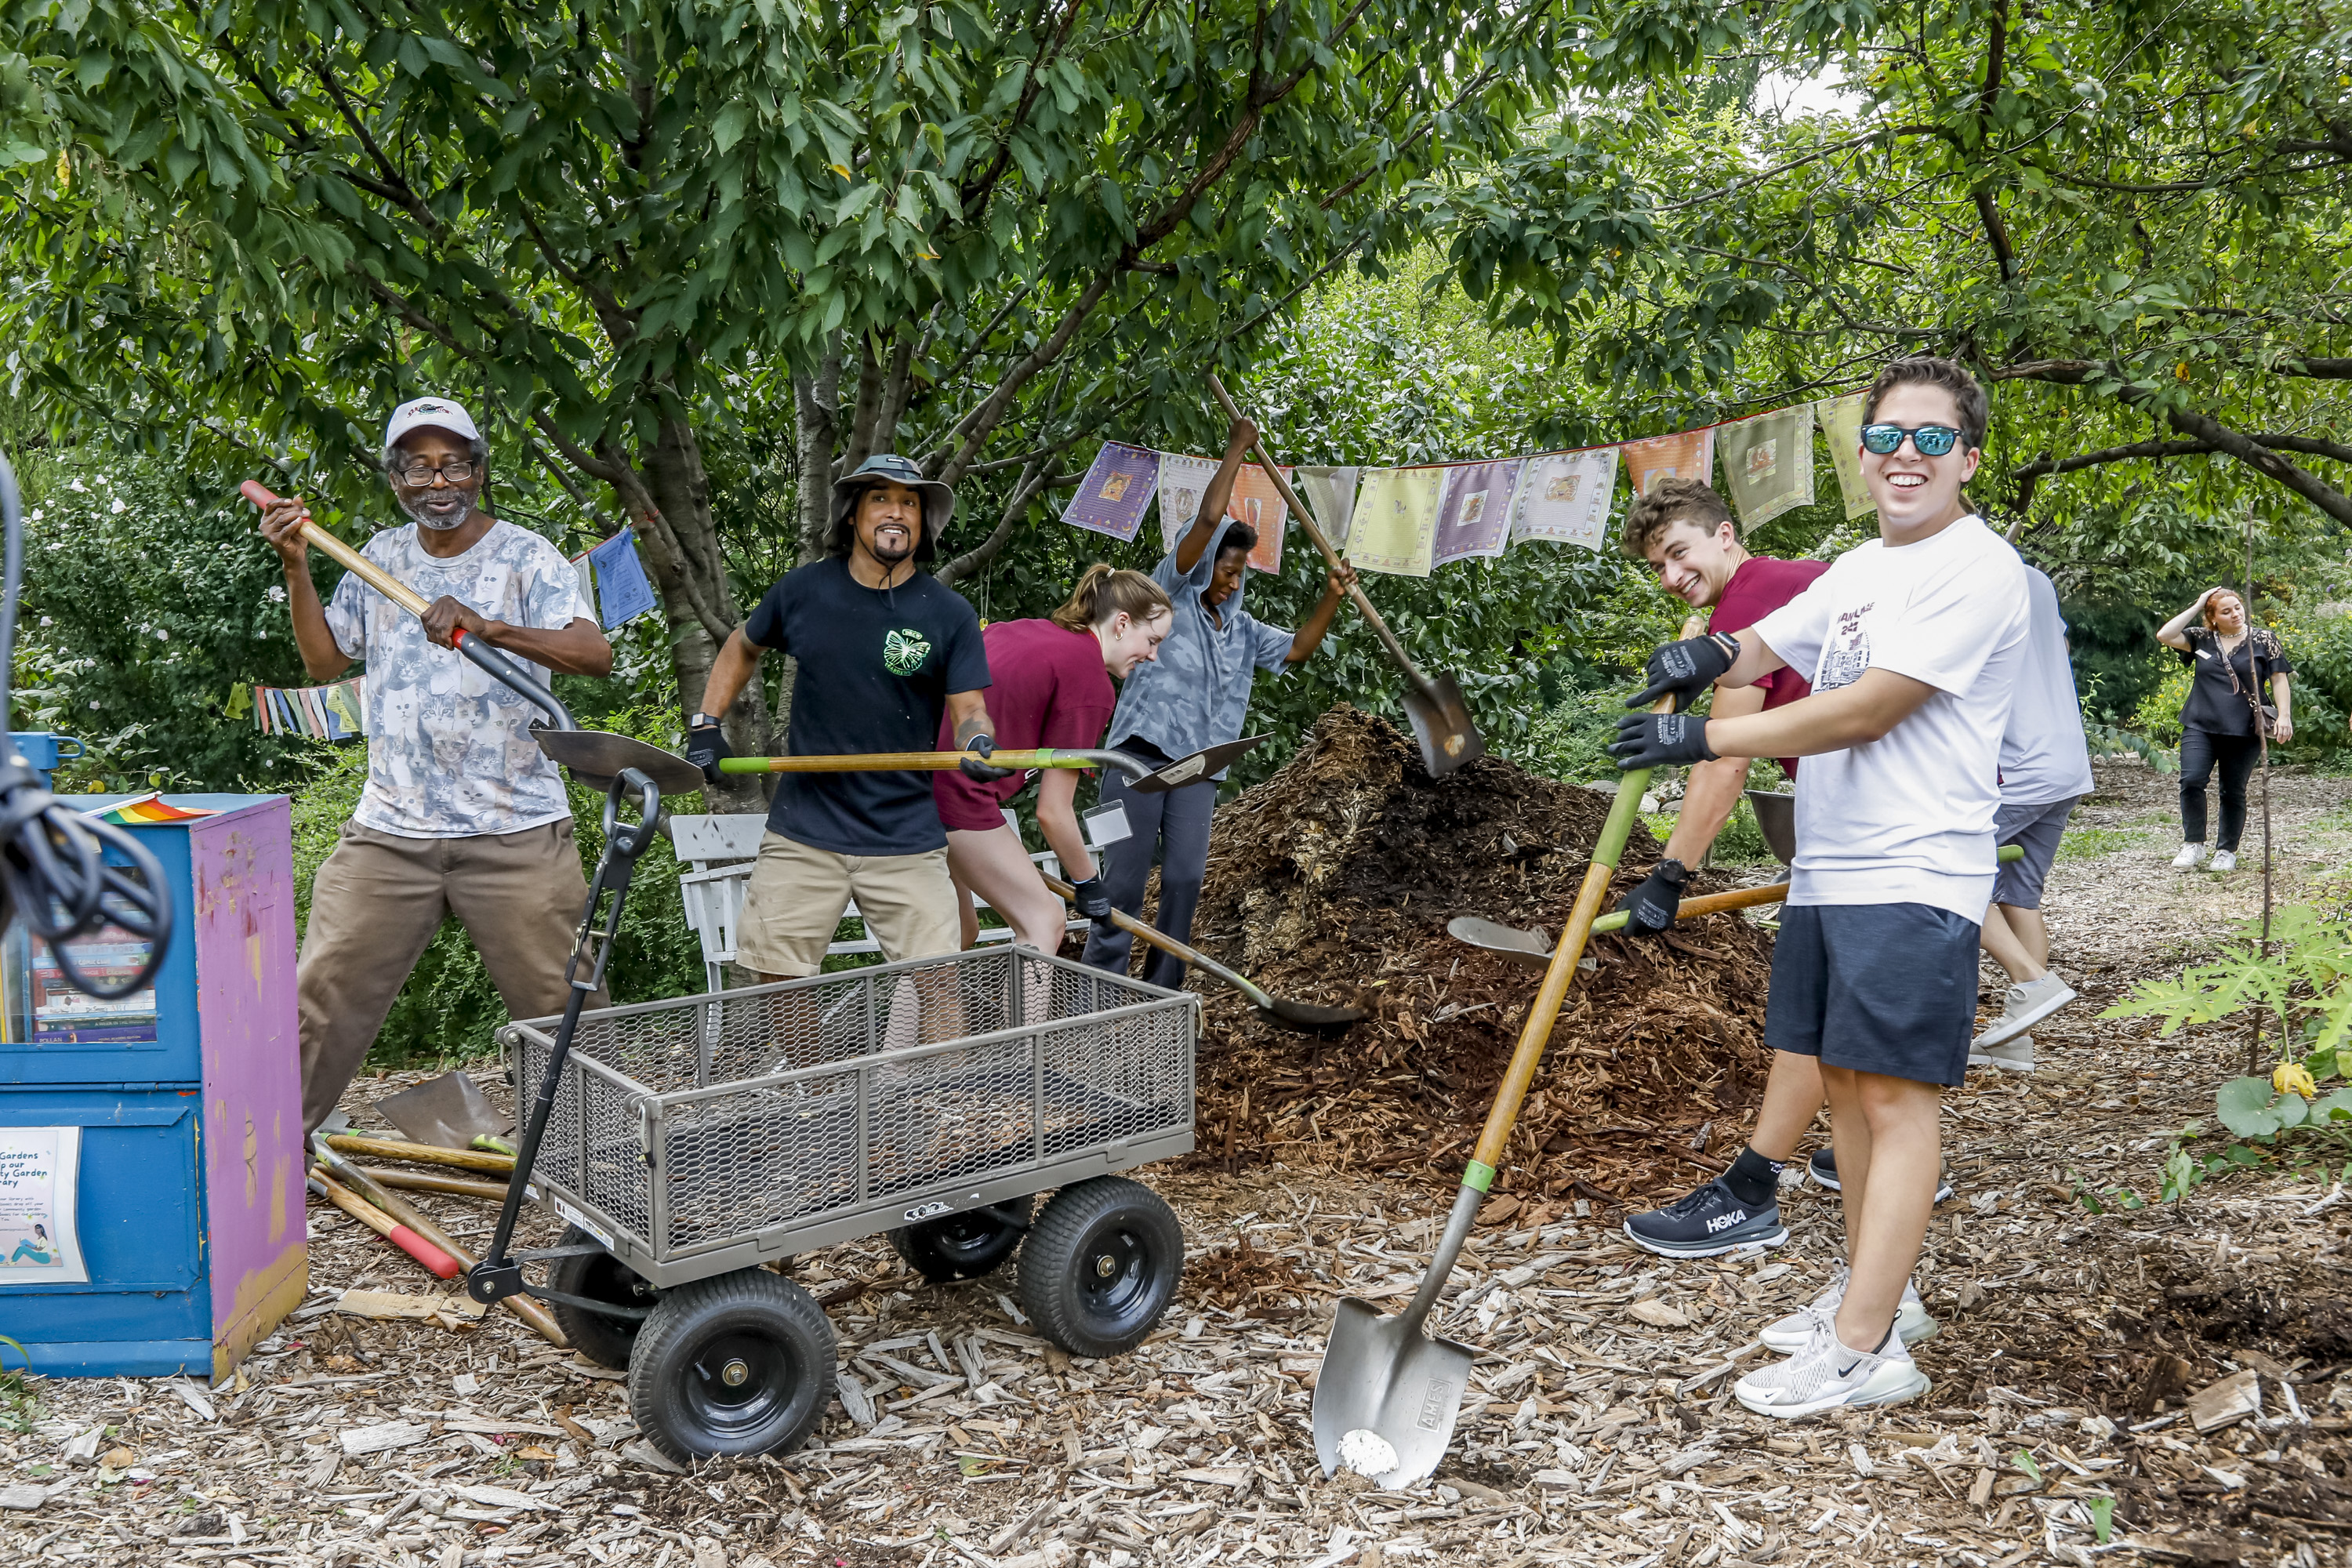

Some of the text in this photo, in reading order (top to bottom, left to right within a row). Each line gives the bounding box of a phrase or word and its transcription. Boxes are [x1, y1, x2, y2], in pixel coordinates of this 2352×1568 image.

[0, 1151, 38, 1160] Gardens
[13, 1168, 48, 1178] Garden
[1706, 1209, 1747, 1233] HOKA
[1421, 1384, 1443, 1427] AMES
